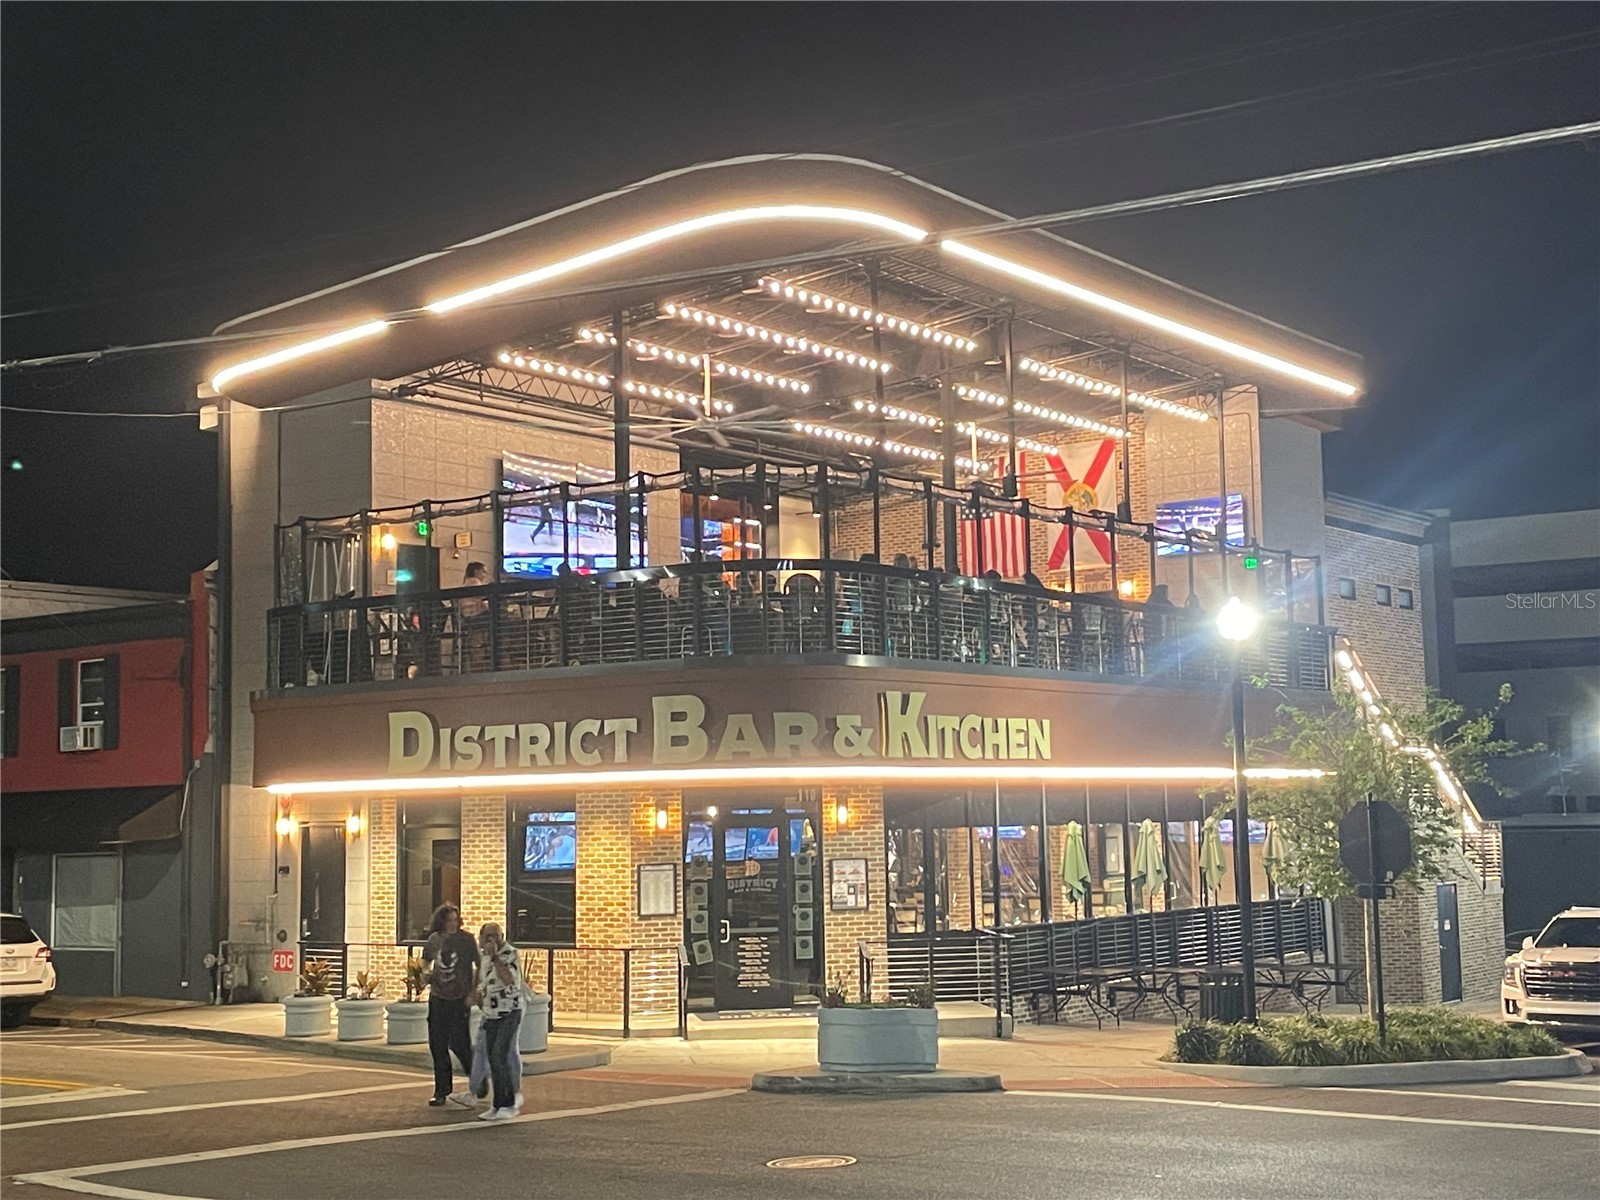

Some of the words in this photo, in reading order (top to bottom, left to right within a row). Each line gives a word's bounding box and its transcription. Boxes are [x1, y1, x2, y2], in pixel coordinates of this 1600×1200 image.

[387, 710, 639, 775] DISTRICT
[651, 694, 823, 765] BAR
[832, 714, 878, 759] &
[880, 690, 1052, 760] KITCHEN
[727, 878, 779, 890] DISTRICT
[273, 954, 294, 969] FDC
